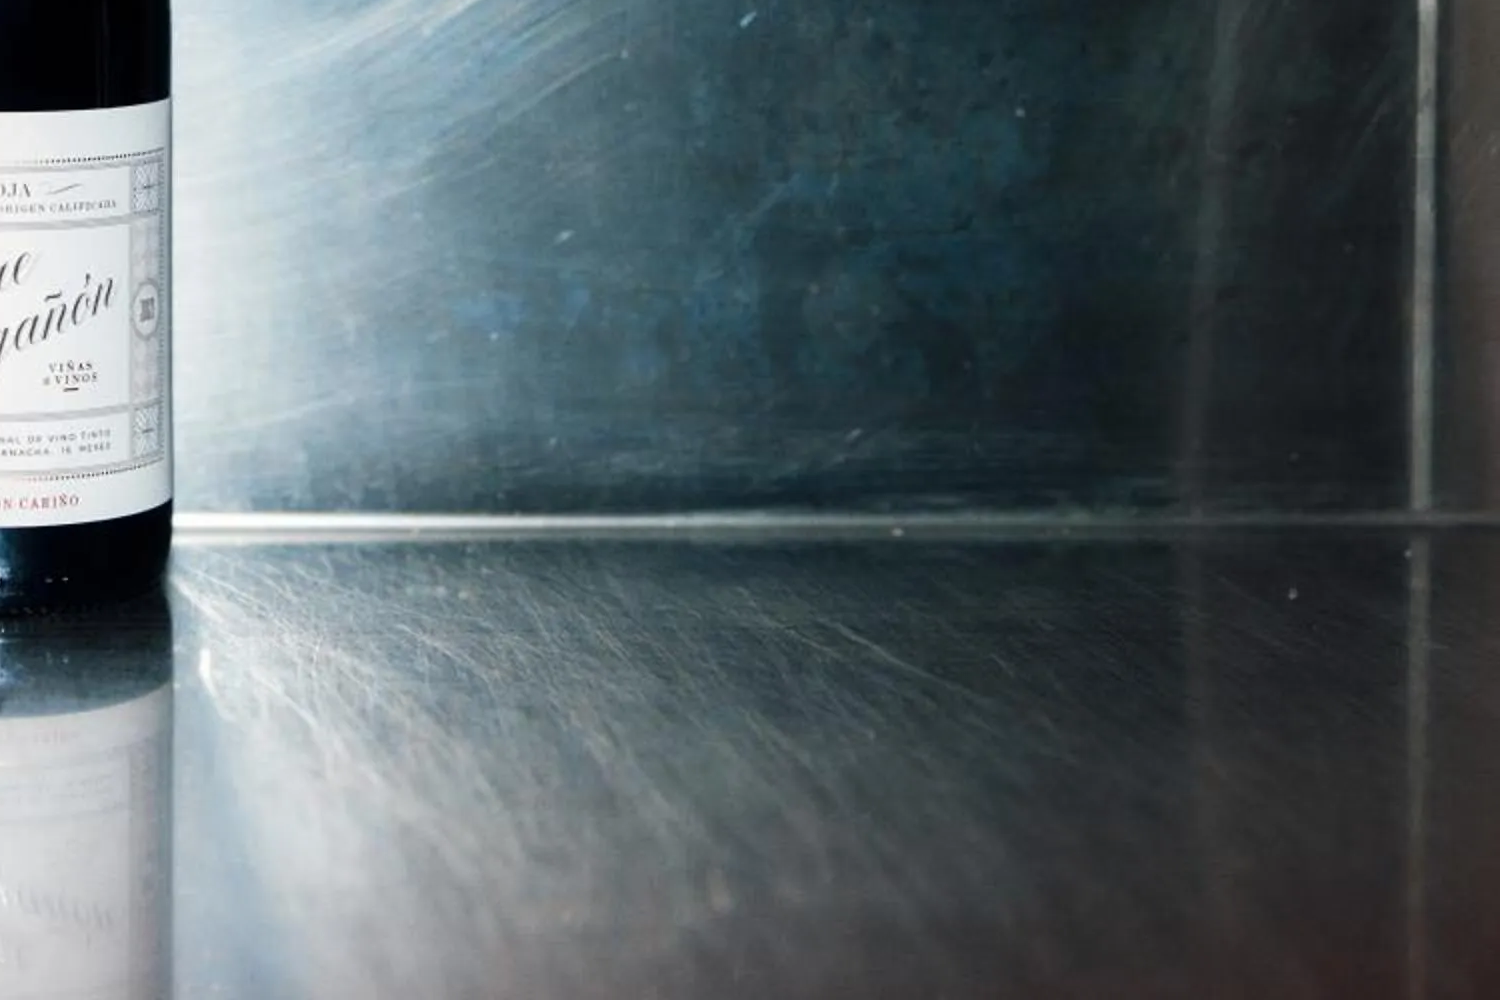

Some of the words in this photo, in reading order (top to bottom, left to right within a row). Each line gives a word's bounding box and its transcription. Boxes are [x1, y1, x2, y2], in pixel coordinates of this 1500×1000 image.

[48, 360, 93, 373] VIÑAS
[55, 372, 98, 384] VINOS
[19, 493, 80, 509] CARIÑO
